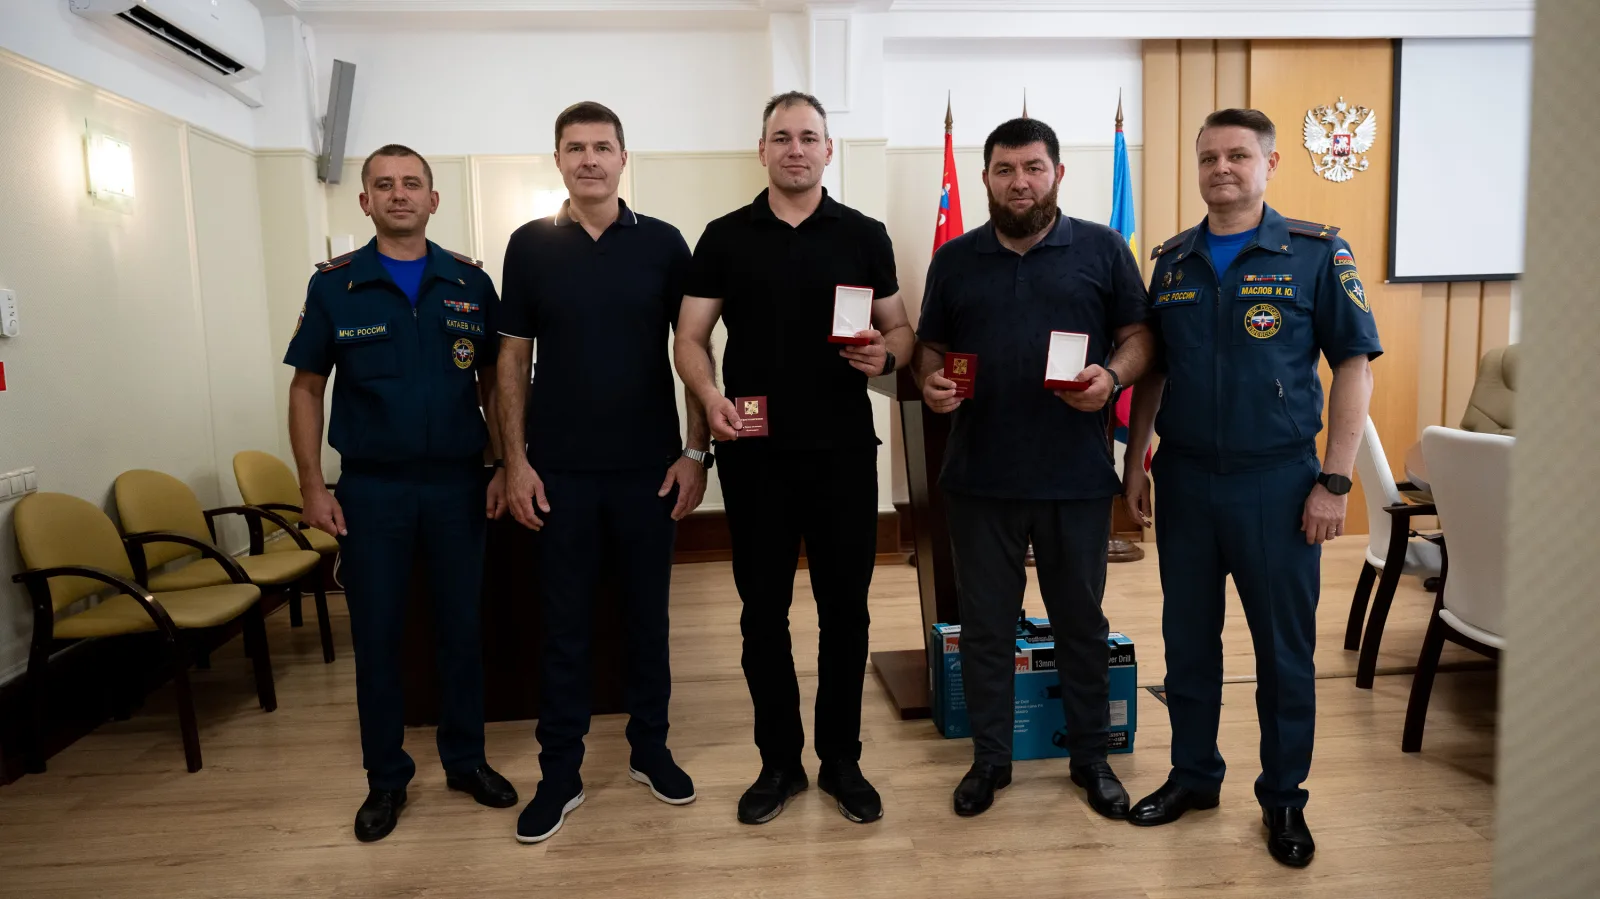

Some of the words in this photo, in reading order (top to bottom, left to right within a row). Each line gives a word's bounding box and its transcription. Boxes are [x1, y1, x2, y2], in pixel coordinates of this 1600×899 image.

[1159, 293, 1171, 302] МЧС
[1171, 291, 1196, 301] РОССИИ
[1241, 286, 1273, 295] МАСЛОВ
[1275, 287, 1283, 295] И.
[1284, 287, 1294, 296] Ю.
[446, 319, 469, 330] КАТАЕВ
[339, 329, 355, 337] МЧС
[357, 325, 386, 337] РОССИИ
[1119, 654, 1131, 663] Drill
